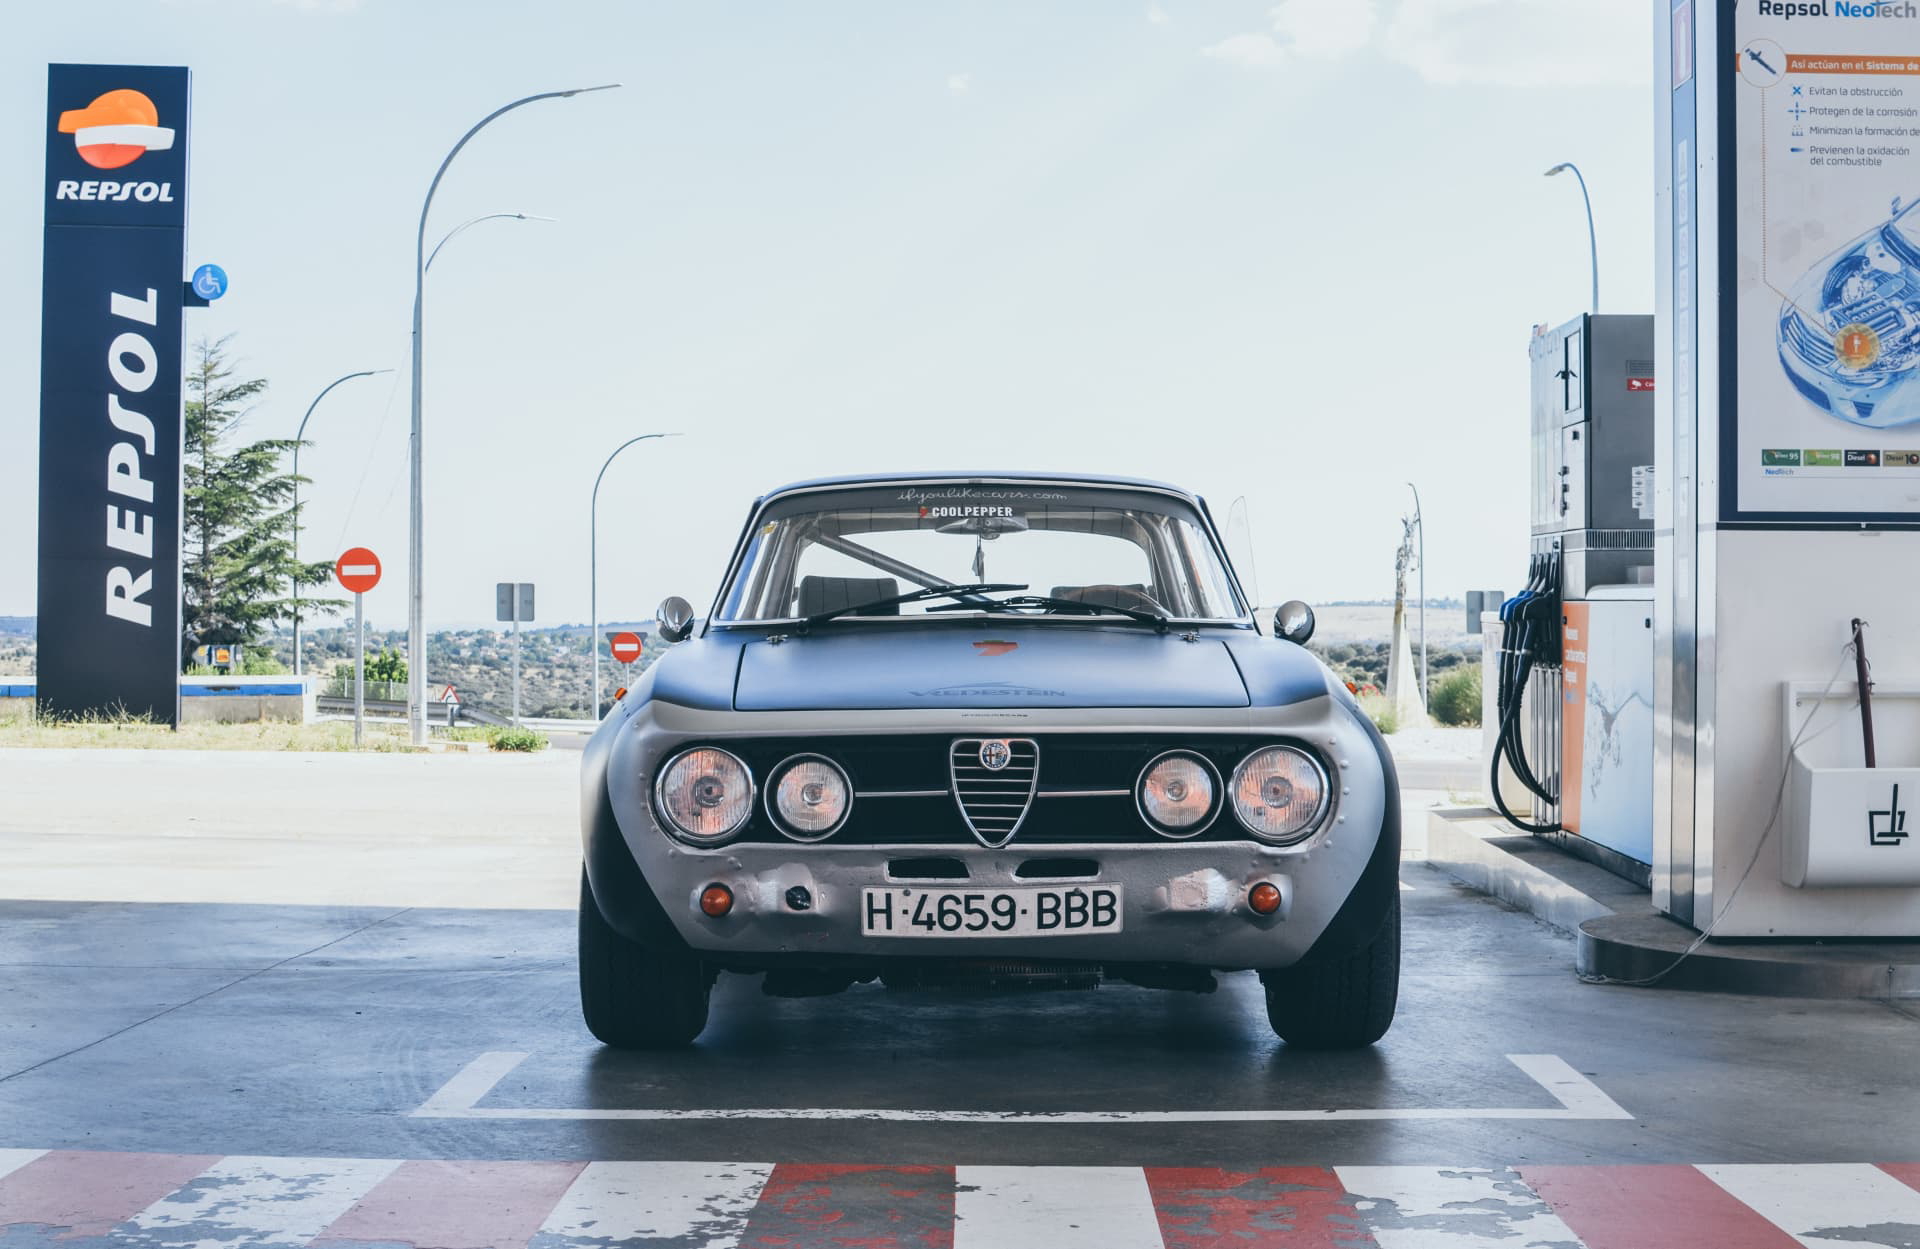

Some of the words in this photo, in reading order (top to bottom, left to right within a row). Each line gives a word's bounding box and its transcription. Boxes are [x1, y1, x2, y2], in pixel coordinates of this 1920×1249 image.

[1759, 0, 1829, 20] Repsol
[1835, 1, 1917, 18] NeoTech
[1791, 60, 1806, 69] Así
[1808, 60, 1839, 70] actúan
[1842, 62, 1853, 70] en
[1855, 61, 1864, 70] el
[1866, 61, 1905, 71] Sistema
[1907, 61, 1919, 71] de
[1809, 87, 1837, 96] Evitan
[1840, 87, 1848, 96] la
[1850, 87, 1903, 97] obstrucción
[1809, 107, 1850, 117] Protegen
[1852, 107, 1864, 116] de
[1866, 107, 1874, 116] la
[1877, 108, 1918, 117] corrosión
[1809, 126, 1853, 135] Minimizan
[1855, 127, 1863, 136] la
[1864, 127, 1908, 136] formación
[1910, 127, 1920, 136] de
[1810, 146, 1854, 155] Previenen
[1857, 146, 1865, 155] la
[1867, 146, 1910, 156] oxidación
[1810, 156, 1824, 165] del
[1827, 157, 1882, 166] combustible
[56, 180, 174, 202] REPSOL
[106, 287, 158, 627] REPSOL
[1886, 454, 1904, 462] Diesel
[897, 488, 1068, 504] ifyoulikecars.com
[932, 506, 1013, 517] COOLPEPPER
